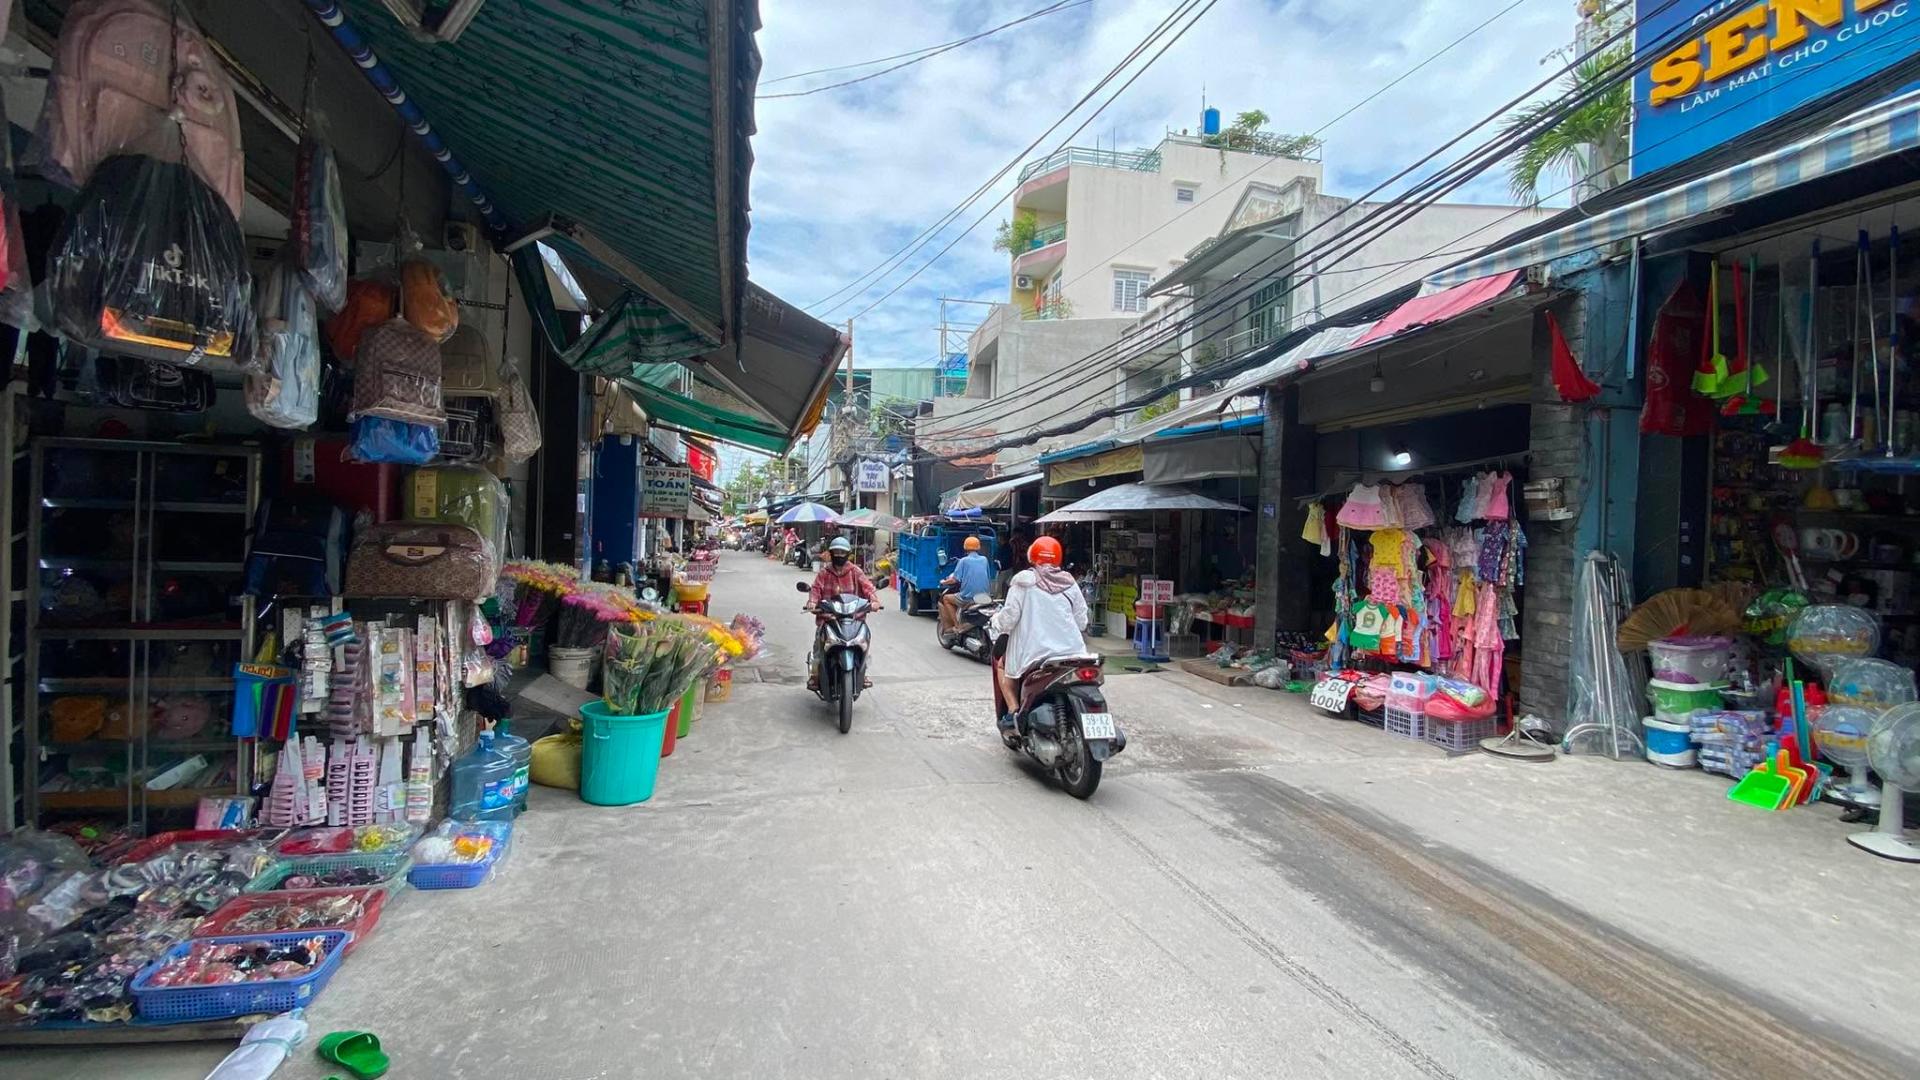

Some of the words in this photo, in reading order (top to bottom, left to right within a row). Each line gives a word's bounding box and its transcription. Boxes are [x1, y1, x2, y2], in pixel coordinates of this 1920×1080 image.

[1650, 0, 1901, 106] SEN
[1777, 39, 1828, 68] CHO
[646, 477, 685, 489] TOÁN
[1311, 692, 1344, 711] 100K
